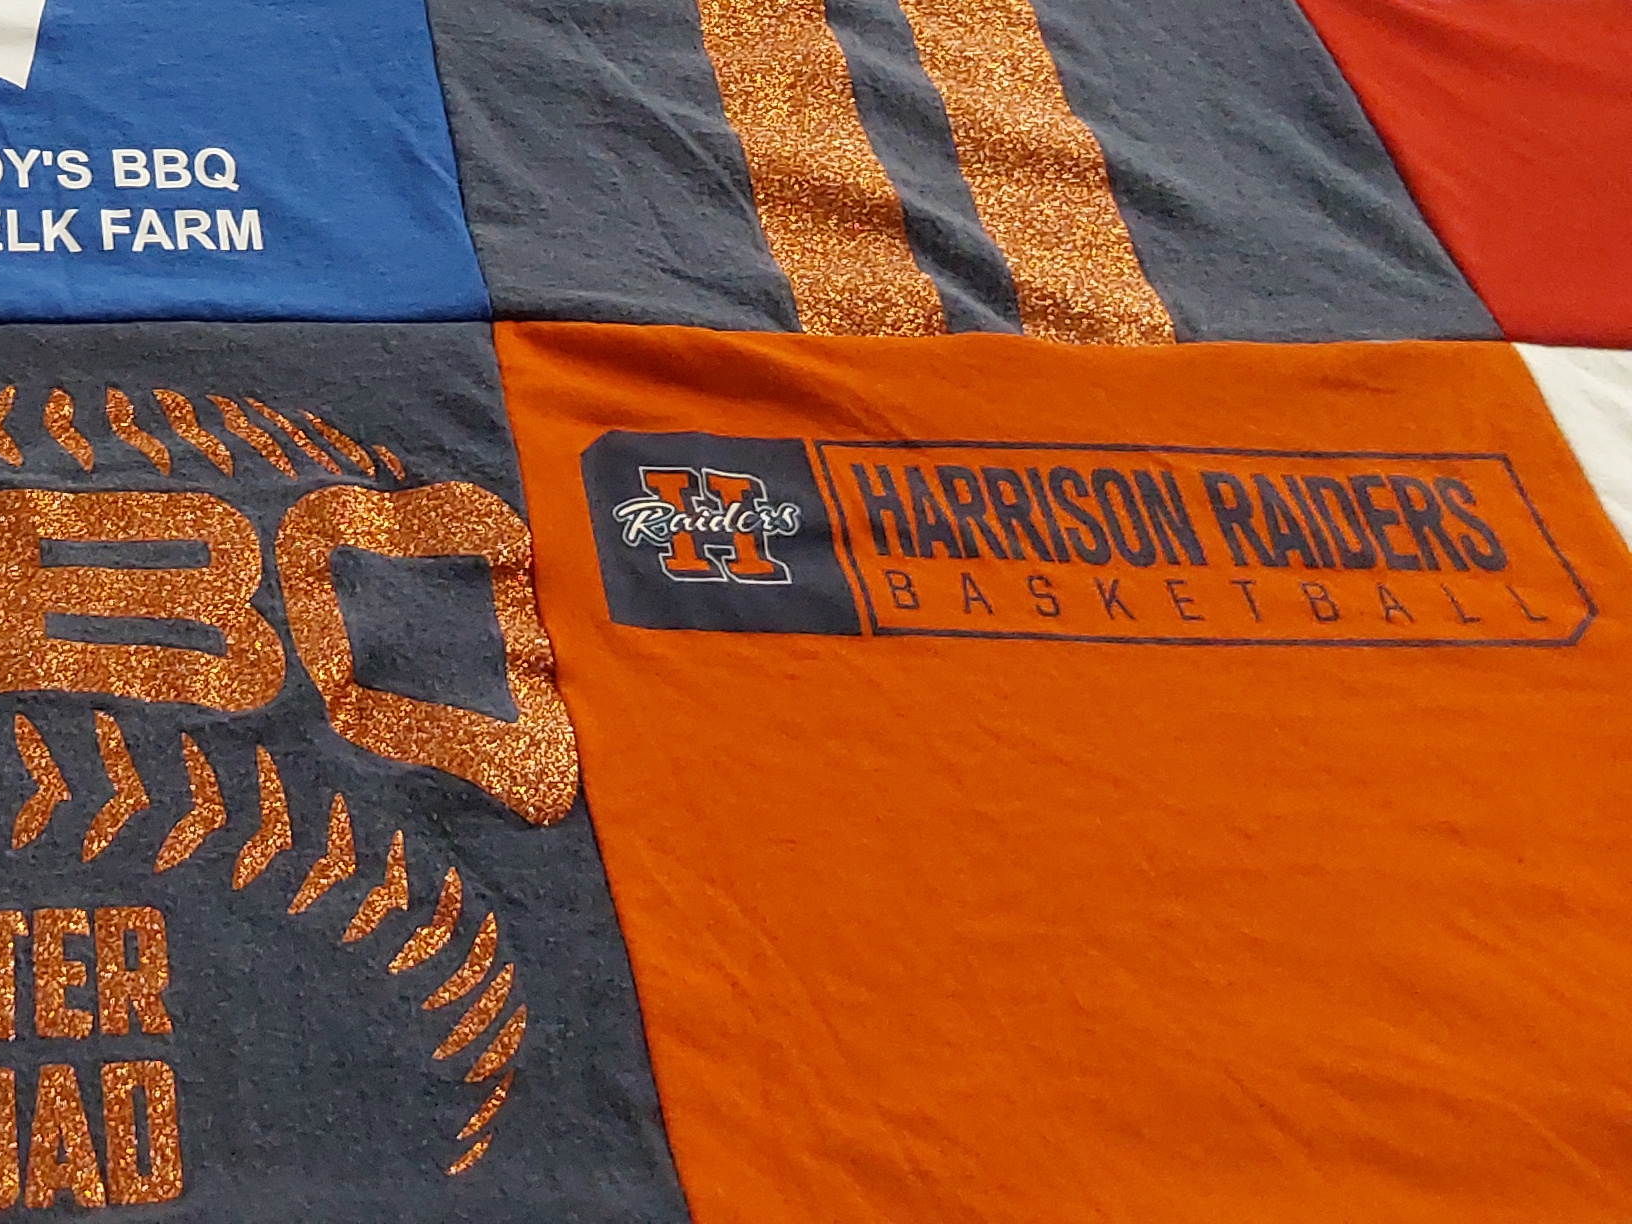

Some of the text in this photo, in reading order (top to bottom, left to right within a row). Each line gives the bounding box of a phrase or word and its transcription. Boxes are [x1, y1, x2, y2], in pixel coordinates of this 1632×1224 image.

[112, 147, 240, 192] BBQ
[100, 208, 265, 252] FARM
[613, 496, 802, 548] Raiders
[849, 461, 1509, 573] HARRISON RAIDERS
[883, 568, 1552, 625] BASKETBALL
